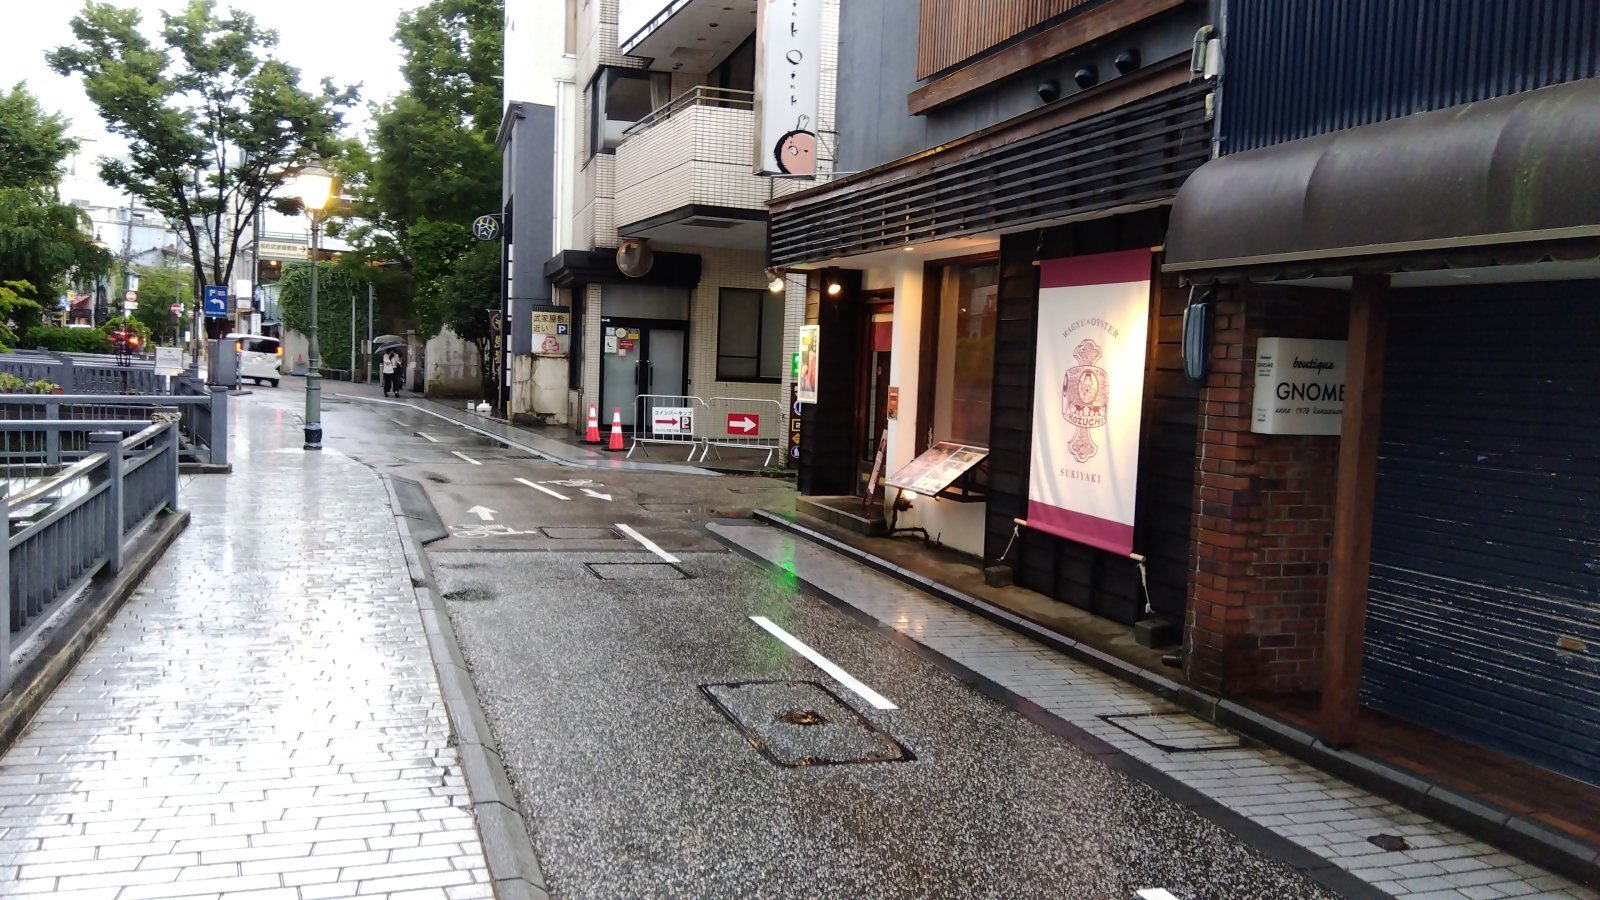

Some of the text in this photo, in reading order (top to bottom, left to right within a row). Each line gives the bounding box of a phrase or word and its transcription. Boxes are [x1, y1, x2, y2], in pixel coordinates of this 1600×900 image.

[533, 324, 549, 333] 近い
[1292, 355, 1335, 375] boutique
[1276, 382, 1345, 402] GNOME
[1068, 413, 1105, 426] KOZUCHI
[1060, 468, 1101, 483] SUKIYAKI
